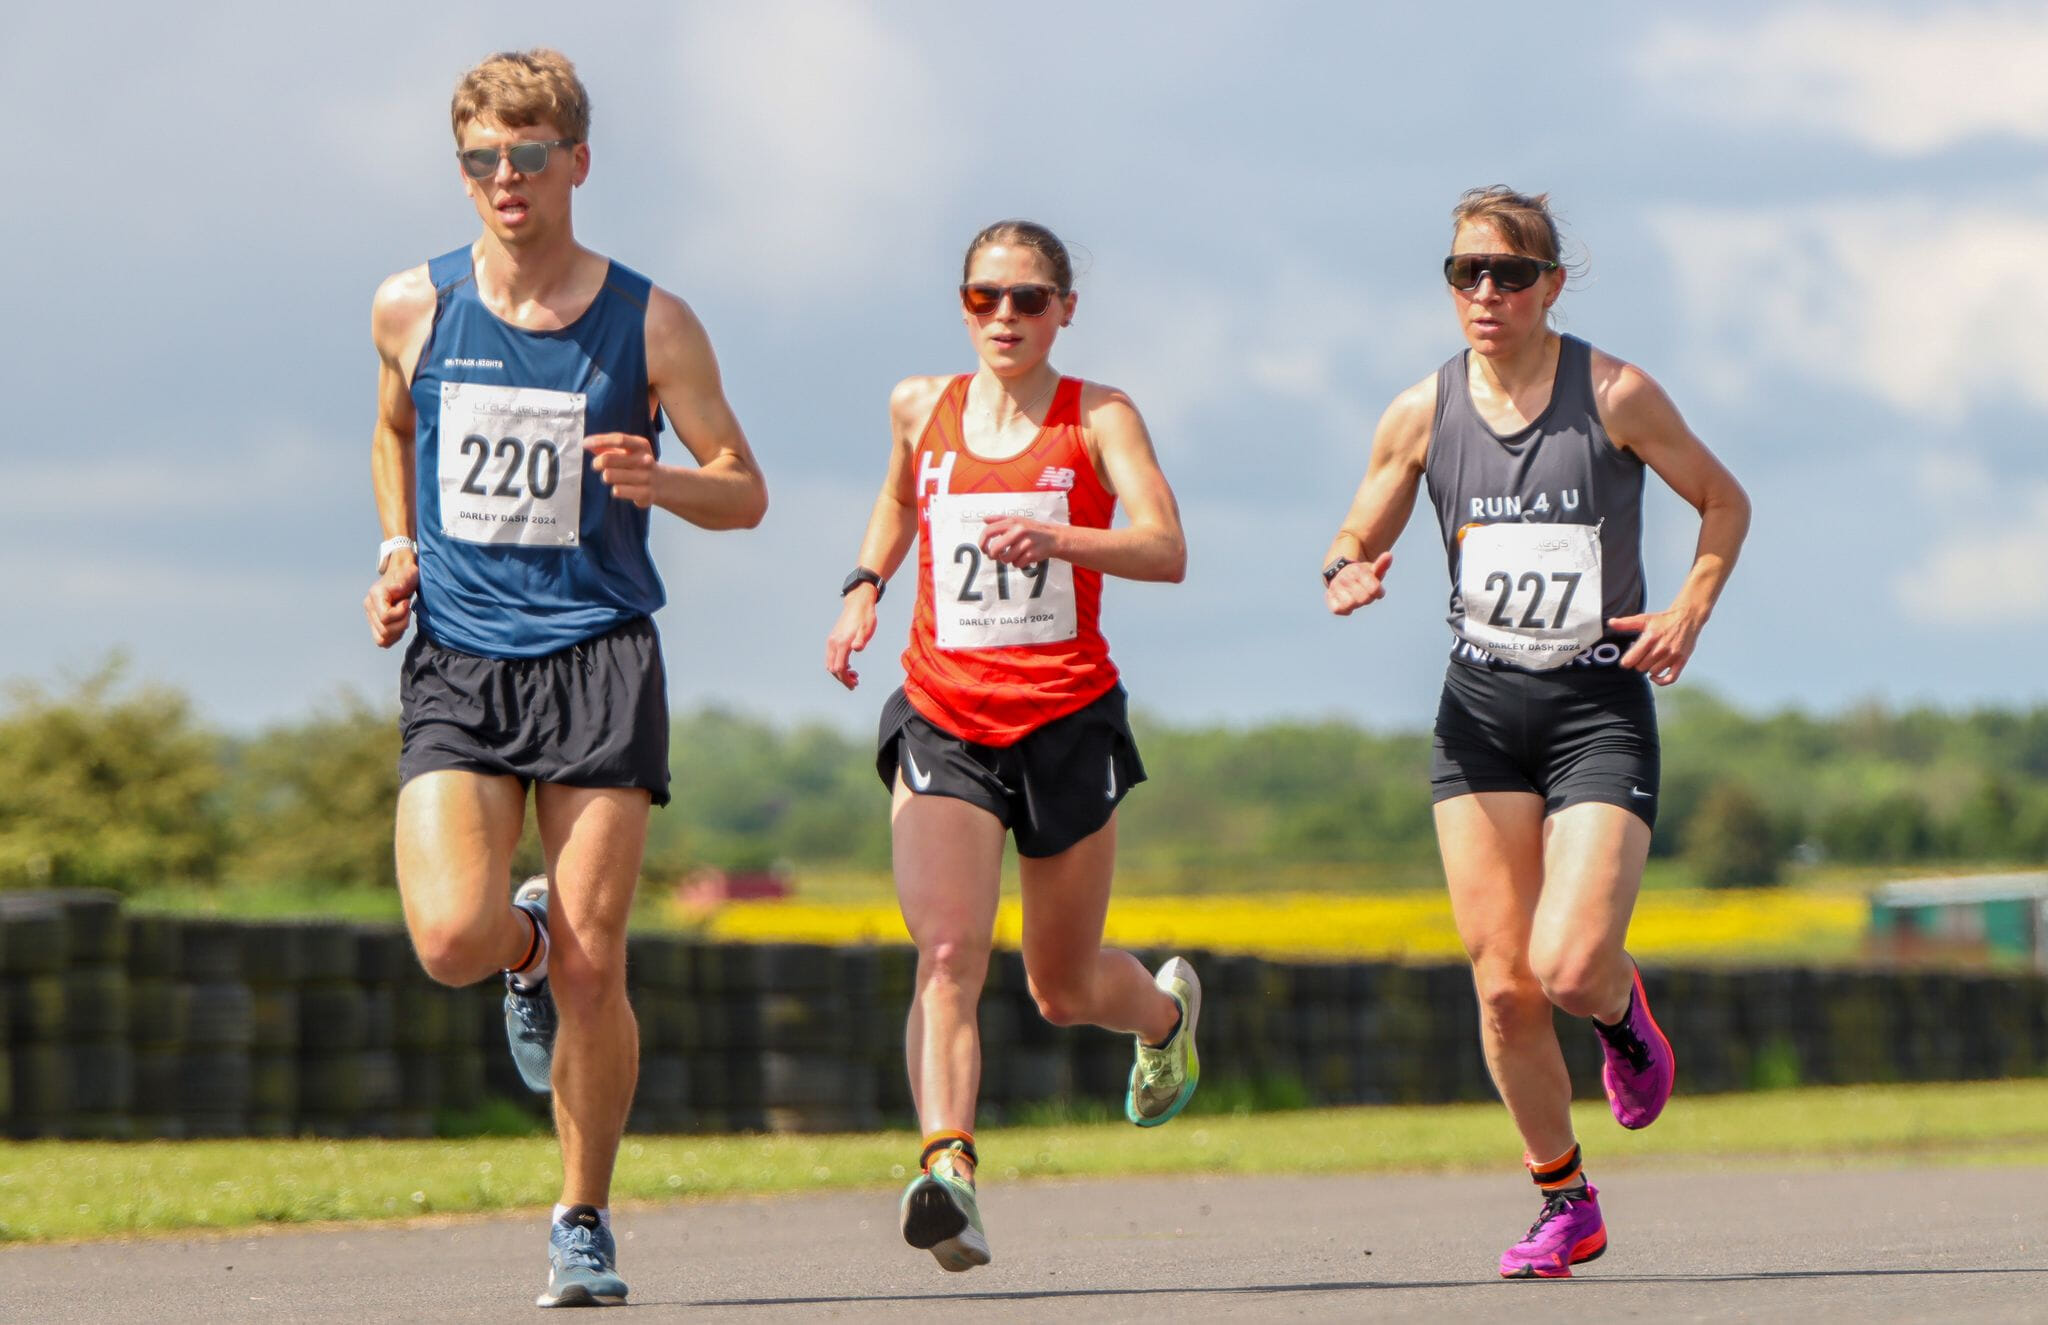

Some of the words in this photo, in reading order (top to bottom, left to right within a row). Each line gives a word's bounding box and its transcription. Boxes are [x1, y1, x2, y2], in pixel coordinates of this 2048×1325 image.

[460, 434, 560, 500] 220
[1471, 496, 1521, 517] RUN
[1533, 492, 1550, 512] 4
[1561, 489, 1579, 509] U
[460, 511, 498, 522] DARLEY
[501, 514, 529, 523] DASH
[531, 516, 557, 525] 2024
[1484, 571, 1582, 629] 227
[959, 617, 996, 626] DARLEY
[1000, 616, 1028, 625] DASH
[1030, 614, 1054, 623] 2024
[1488, 642, 1525, 651] DARLEY
[1528, 643, 1554, 651] DASH
[1557, 643, 1581, 652] 2024
